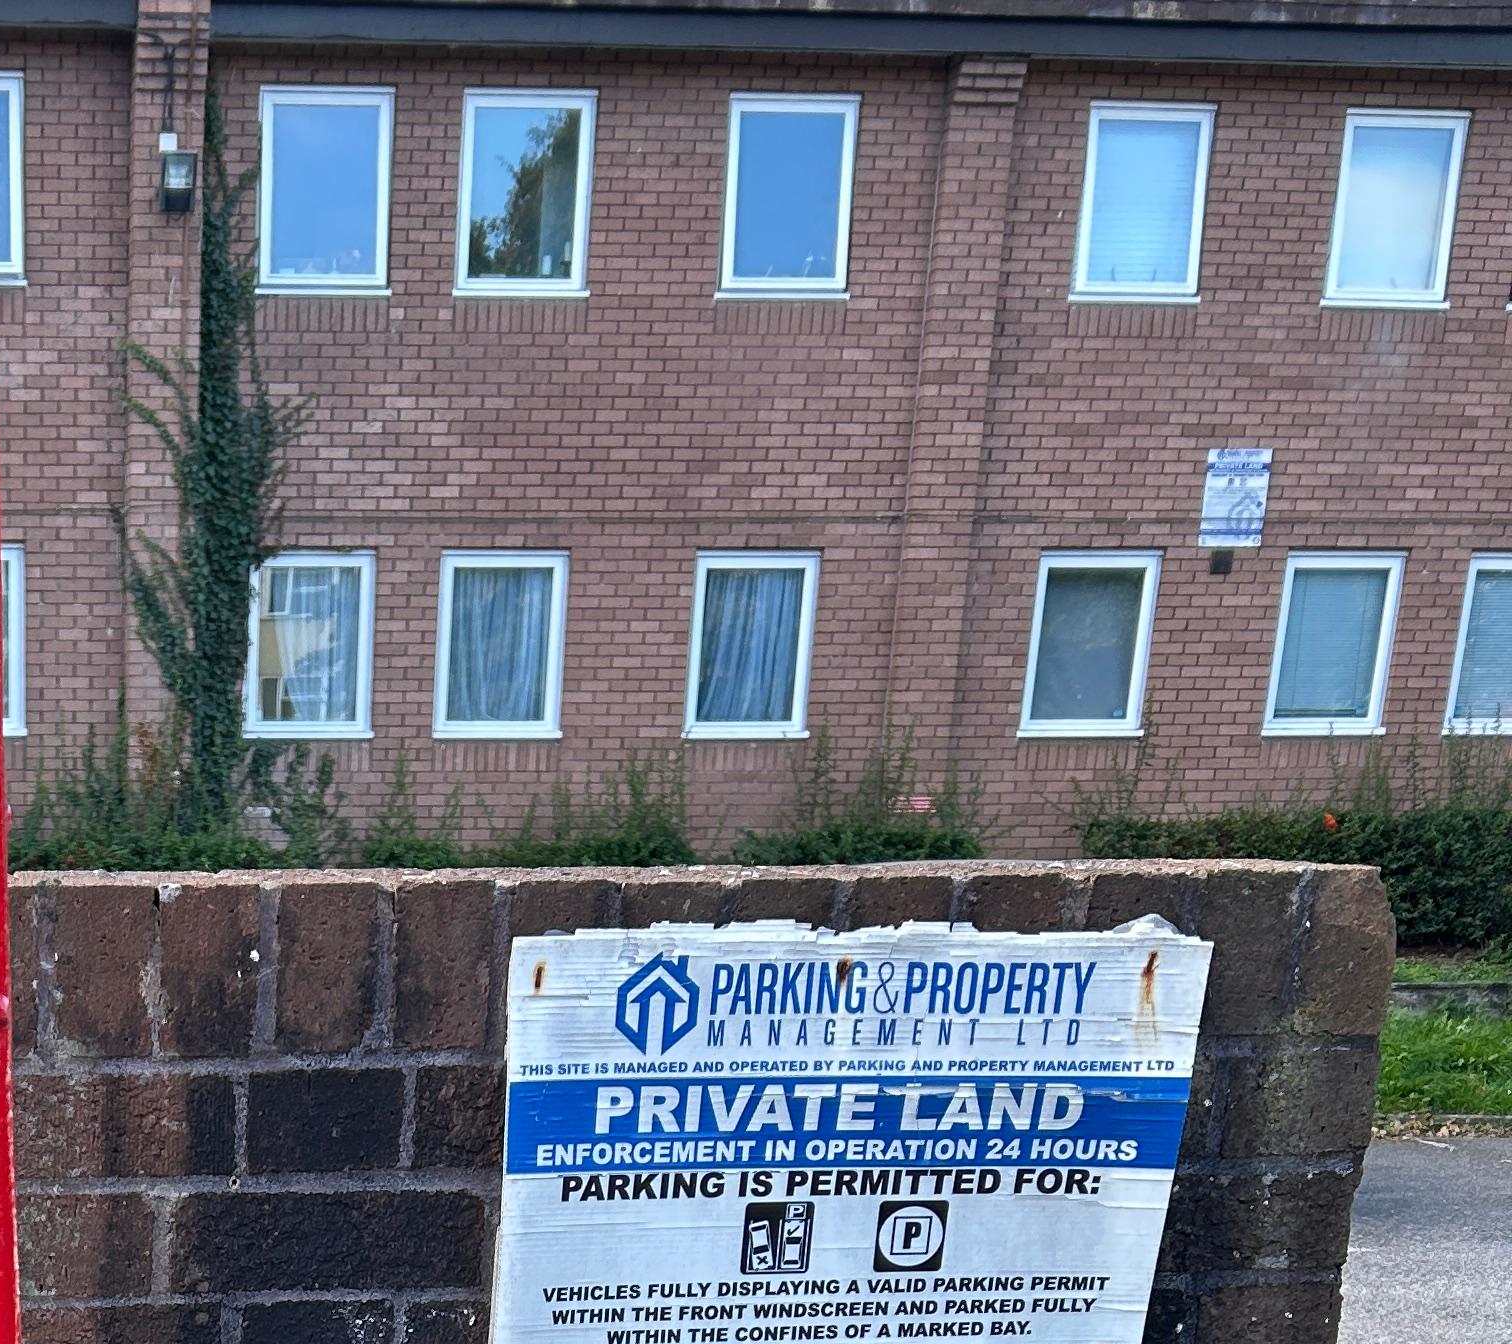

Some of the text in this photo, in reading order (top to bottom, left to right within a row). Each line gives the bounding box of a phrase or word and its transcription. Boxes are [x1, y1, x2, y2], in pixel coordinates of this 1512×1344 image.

[707, 1019, 1081, 1046] MANAGEMENT LTD
[520, 1060, 1175, 1076] THIS SITE IS MANAGED AND OPERATED BY PARKING AND PROPERTY MANAGEMENT LTD
[595, 1083, 1085, 1134] PRIVATE LAND
[537, 1138, 1138, 1167] ENFORCEMENT IN OPERATION 24 HOURS
[561, 1169, 1102, 1201] PARKING IS PERMITTED FOR:
[543, 1276, 1110, 1302] VEHICLES FULLY DISPLAYING A VALID PARKING PERMIT
[552, 1298, 1097, 1325] WITHIN THE FRONT WINDSCREEN AND PARKED FULLY
[607, 1321, 1033, 1344] WITHIN THE CONFINES OF A MARKED BAY.
